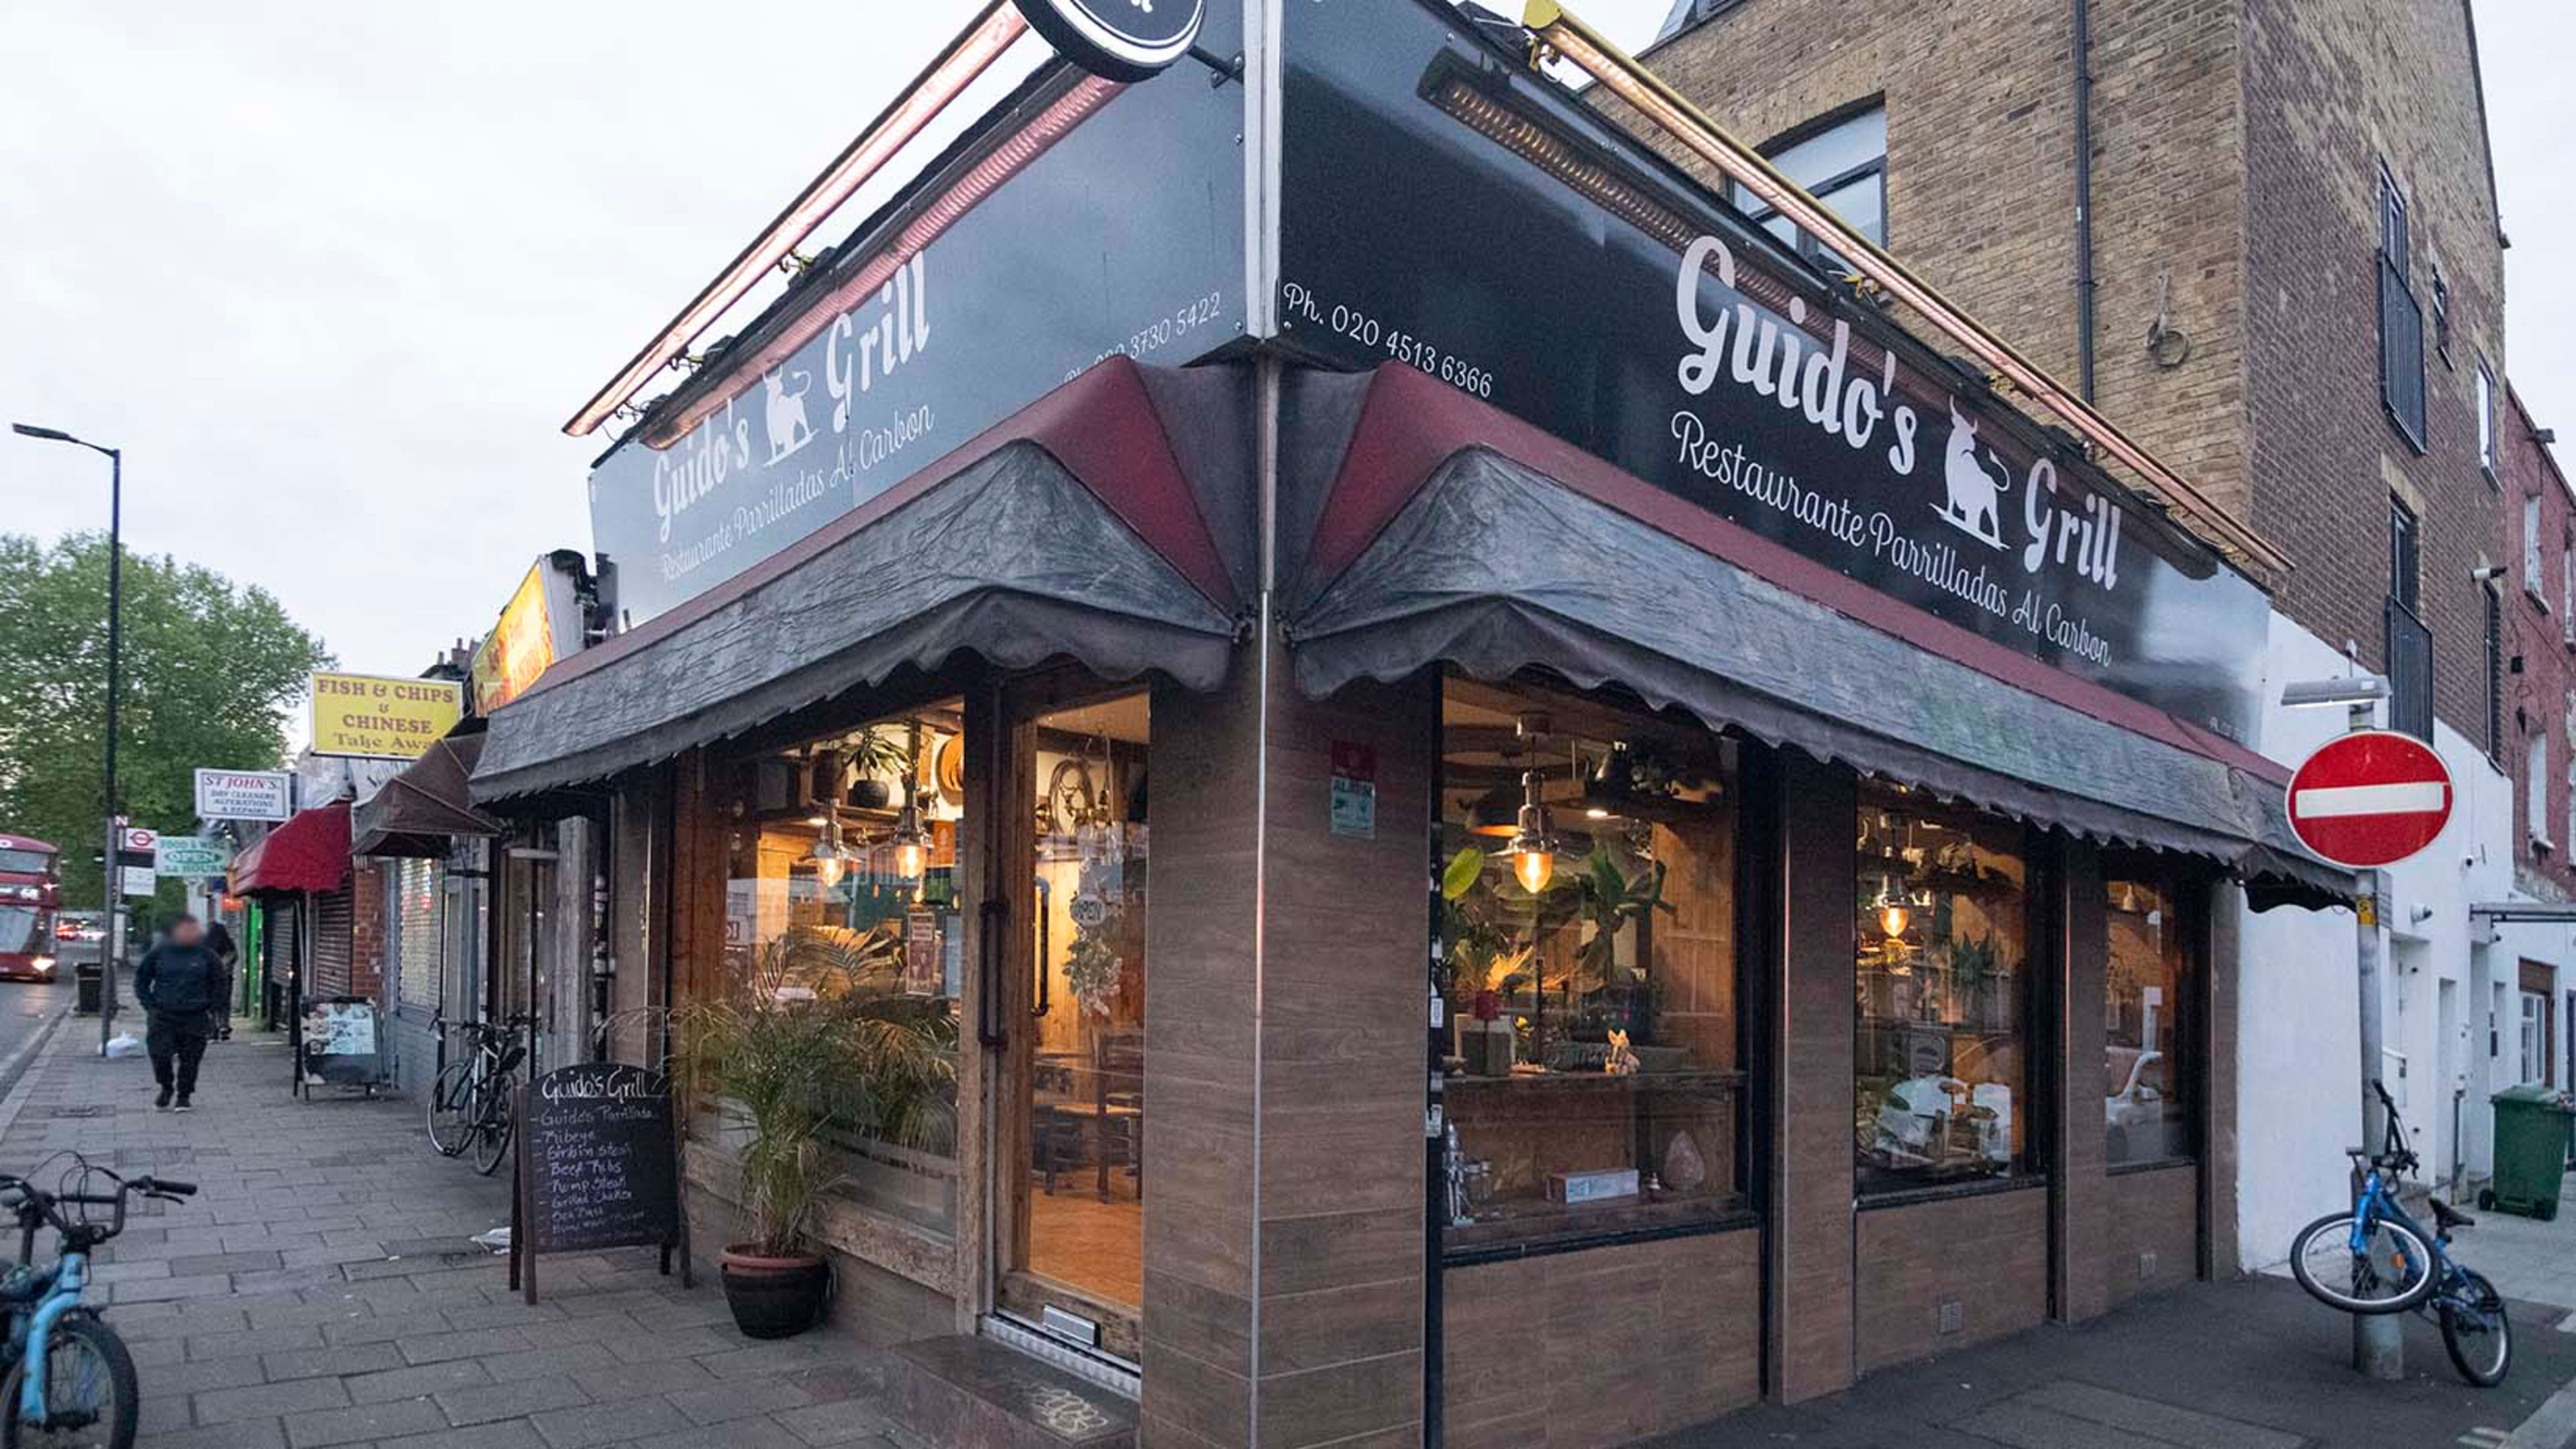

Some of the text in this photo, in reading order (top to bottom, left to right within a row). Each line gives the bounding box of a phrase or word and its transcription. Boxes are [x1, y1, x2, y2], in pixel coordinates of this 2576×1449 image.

[1130, 291, 1220, 360] 3730 5422
[1283, 282, 1493, 398] Ph. 020 4513 6366
[654, 250, 930, 544] Guido's Grill
[1676, 235, 2121, 590] Guido's Grill
[663, 522, 733, 583] Restaurante
[733, 469, 826, 540] Parrilladas
[859, 404, 936, 471] Carbon
[1671, 411, 2112, 668] Restaurante Parrilladas Al Carbon
[318, 679, 453, 703] FISH & CHIPS
[343, 714, 433, 734] CHINESE
[333, 732, 429, 750] Take Awa
[170, 852, 215, 863] OPEN
[541, 1065, 648, 1105] Guido's Grill
